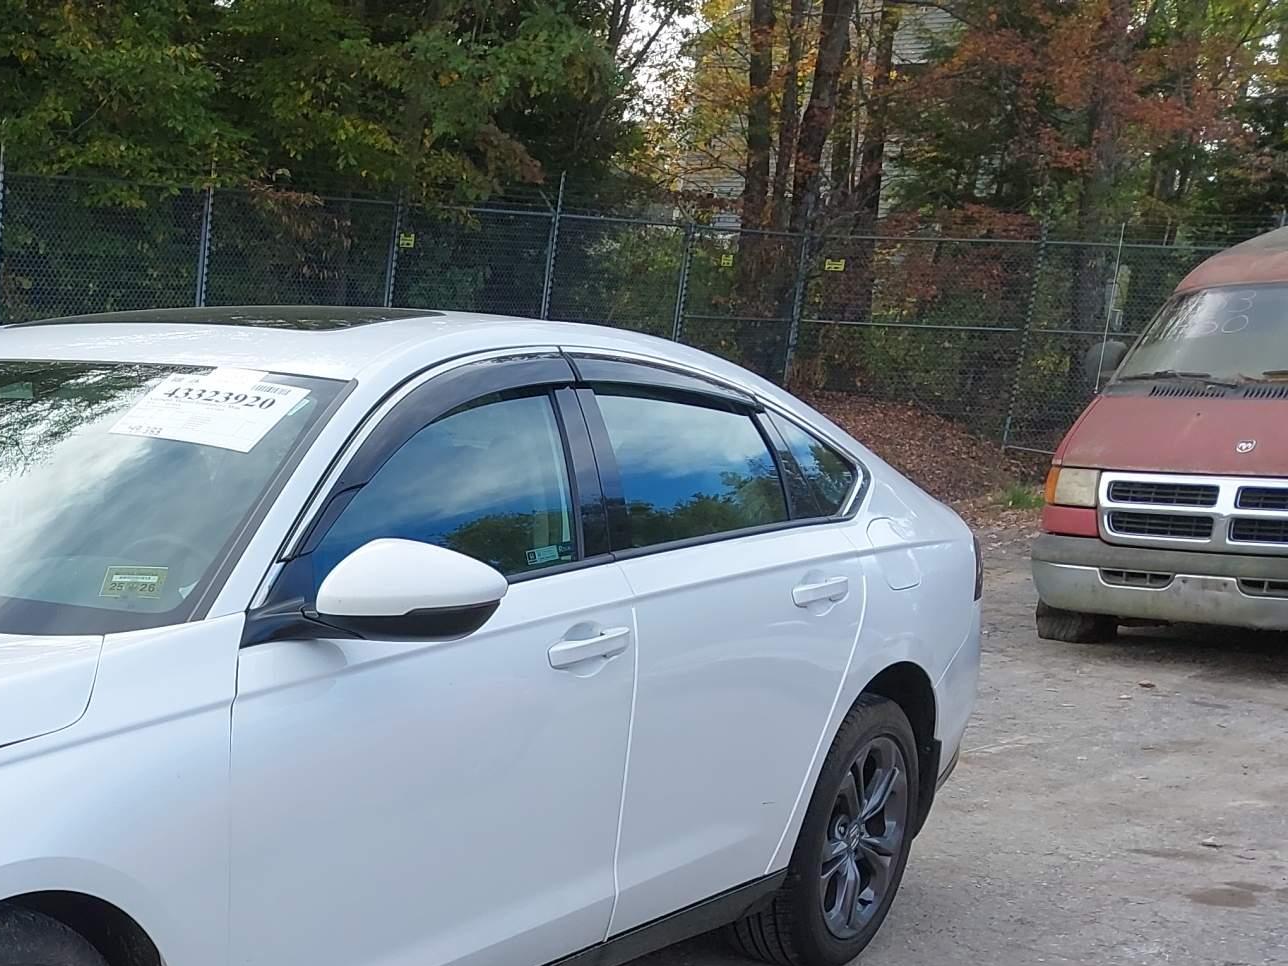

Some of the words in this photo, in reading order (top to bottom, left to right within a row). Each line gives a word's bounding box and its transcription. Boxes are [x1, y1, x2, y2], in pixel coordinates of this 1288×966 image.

[163, 387, 276, 409] 43323920
[109, 582, 125, 591] 25
[139, 583, 156, 593] 26
